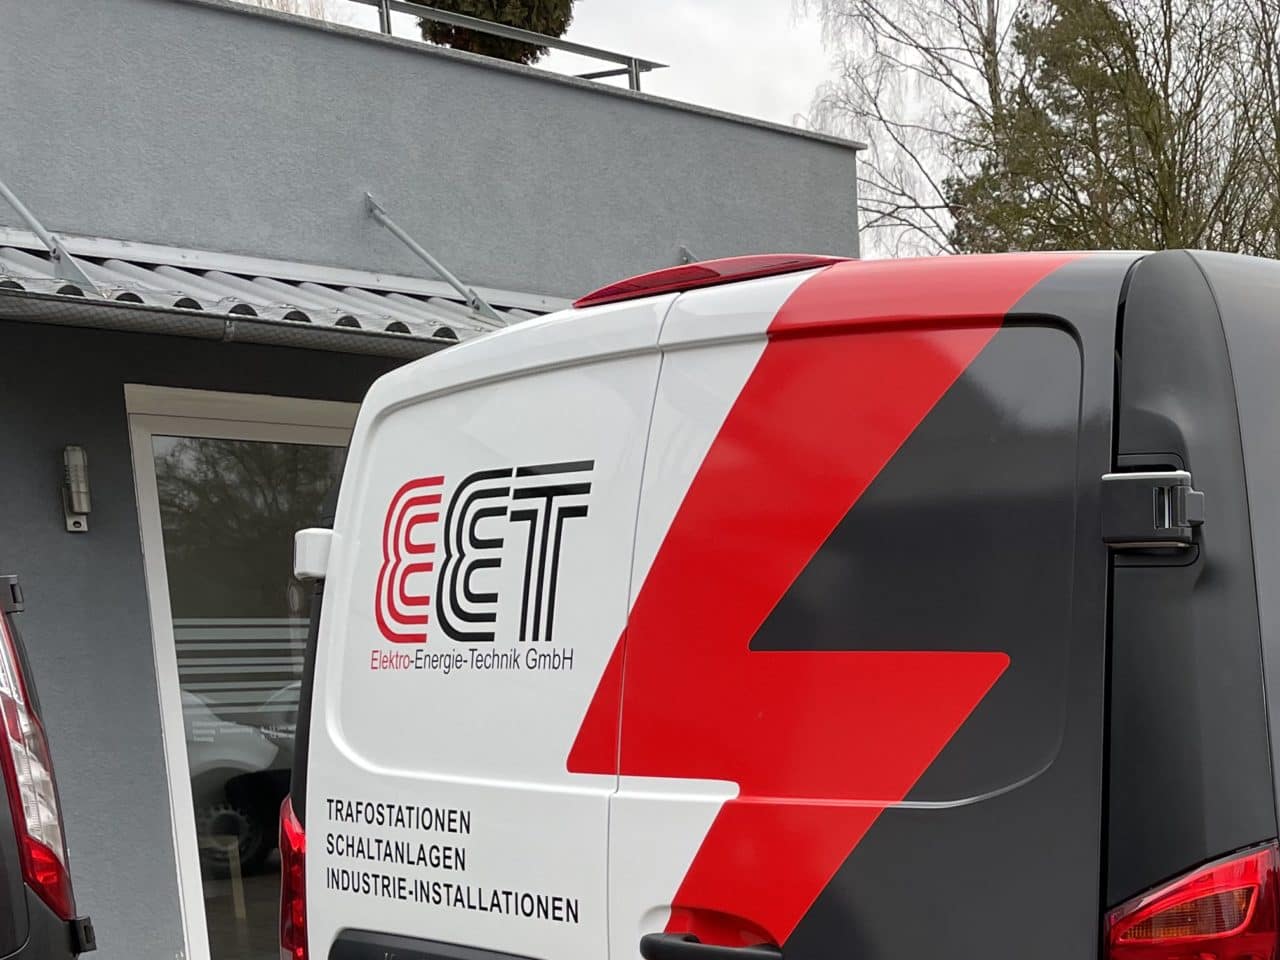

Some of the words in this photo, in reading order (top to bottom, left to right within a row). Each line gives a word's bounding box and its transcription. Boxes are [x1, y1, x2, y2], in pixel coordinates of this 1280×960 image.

[375, 459, 595, 643] EET
[370, 648, 520, 675] Elektro-Energie-Technik
[525, 647, 574, 670] GmbH
[326, 798, 471, 834] TRAFOSTATIONEN
[326, 833, 466, 871] SCHALTANLAGEN
[326, 866, 580, 924] INDUSTRIE-INSTALLATIONEN
